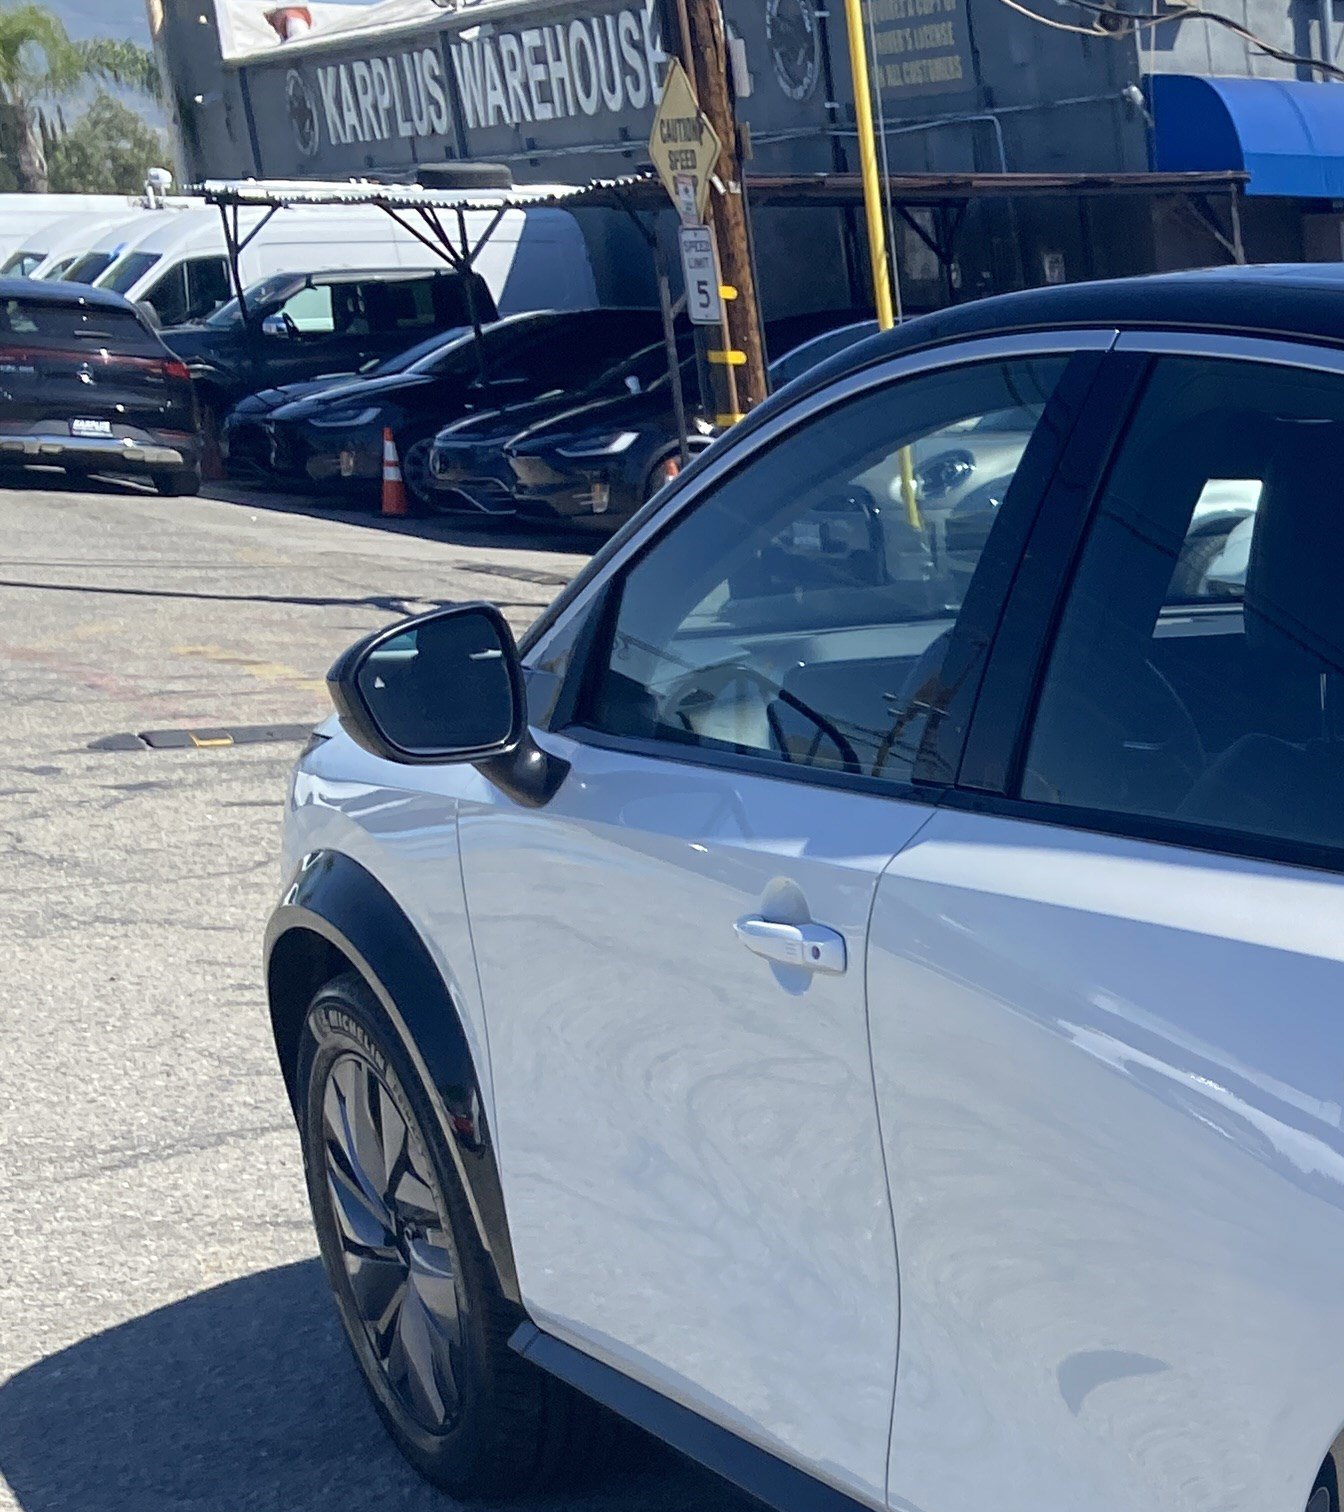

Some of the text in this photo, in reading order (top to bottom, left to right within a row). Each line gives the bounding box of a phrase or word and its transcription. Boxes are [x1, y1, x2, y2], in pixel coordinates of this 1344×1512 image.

[317, 48, 450, 145] KARPLUS
[451, 9, 669, 130] WAREHOUSE
[660, 117, 704, 144] CAUTION
[668, 149, 698, 171] SPEED
[683, 240, 711, 253] SPEED
[687, 257, 710, 270] LIMIT
[696, 280, 711, 309] 5
[329, 1010, 387, 1071] MICHELIN
